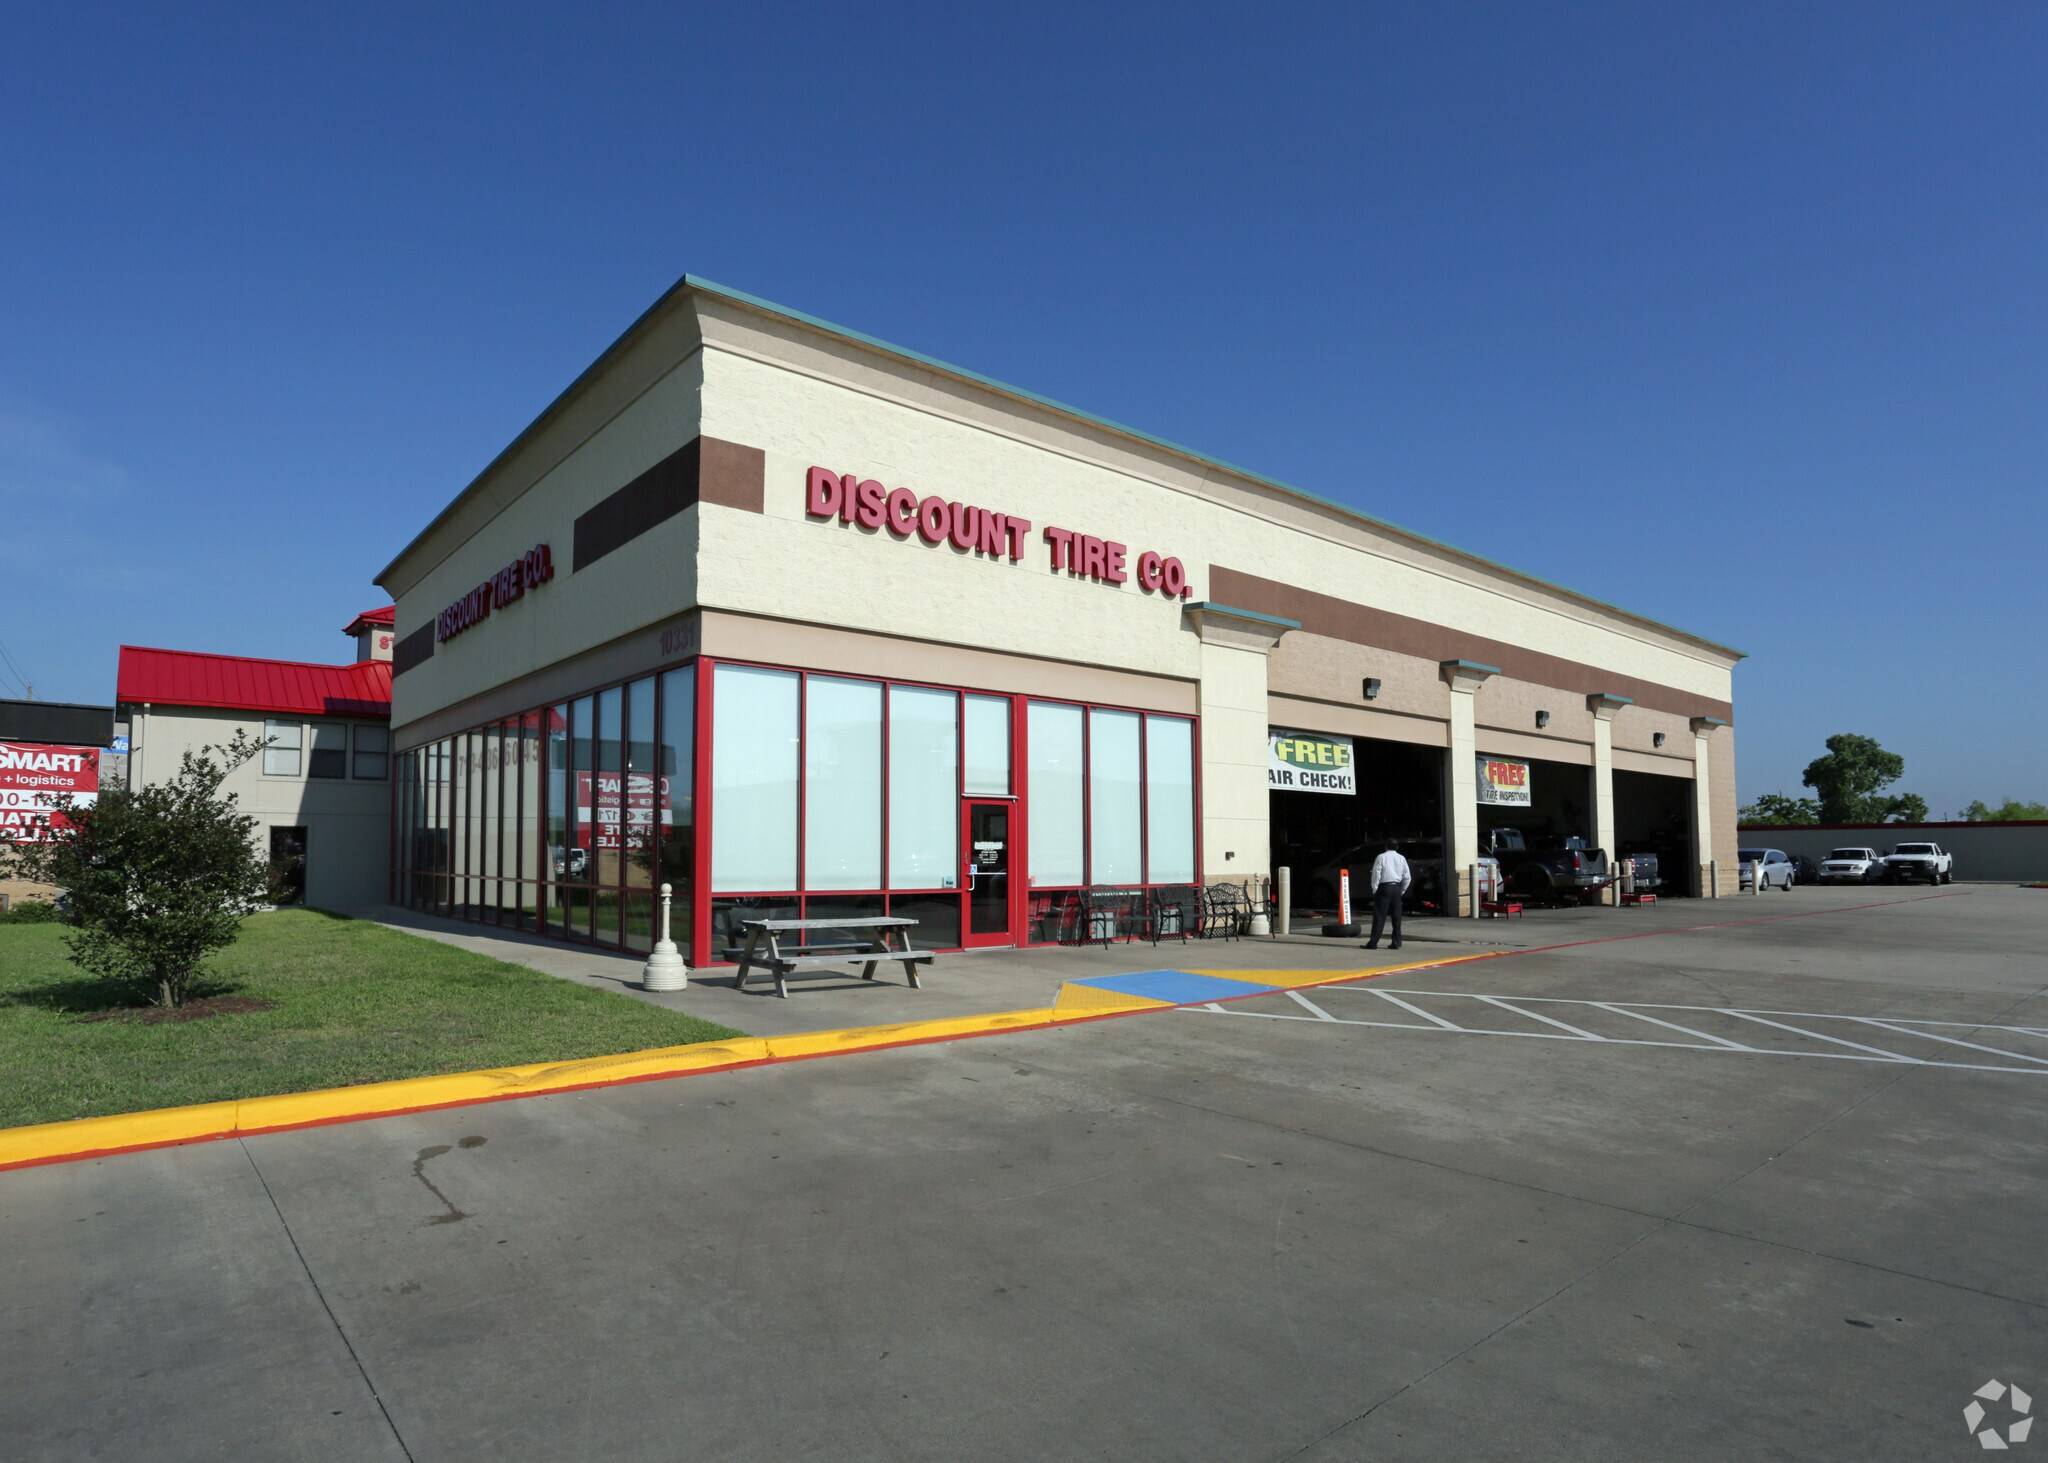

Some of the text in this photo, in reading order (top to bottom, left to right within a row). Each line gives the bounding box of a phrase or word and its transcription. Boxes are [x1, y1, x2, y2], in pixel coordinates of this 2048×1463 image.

[806, 465, 1193, 598] DISCOUNT TIRE CO.
[436, 543, 554, 643] DISCOUNT TIRE CO.
[1278, 738, 1350, 768] FREE
[16, 774, 75, 786] logistics
[1268, 769, 1352, 790] AIR CHECK!
[1487, 761, 1526, 786] FREE
[0, 811, 50, 826] ATE
